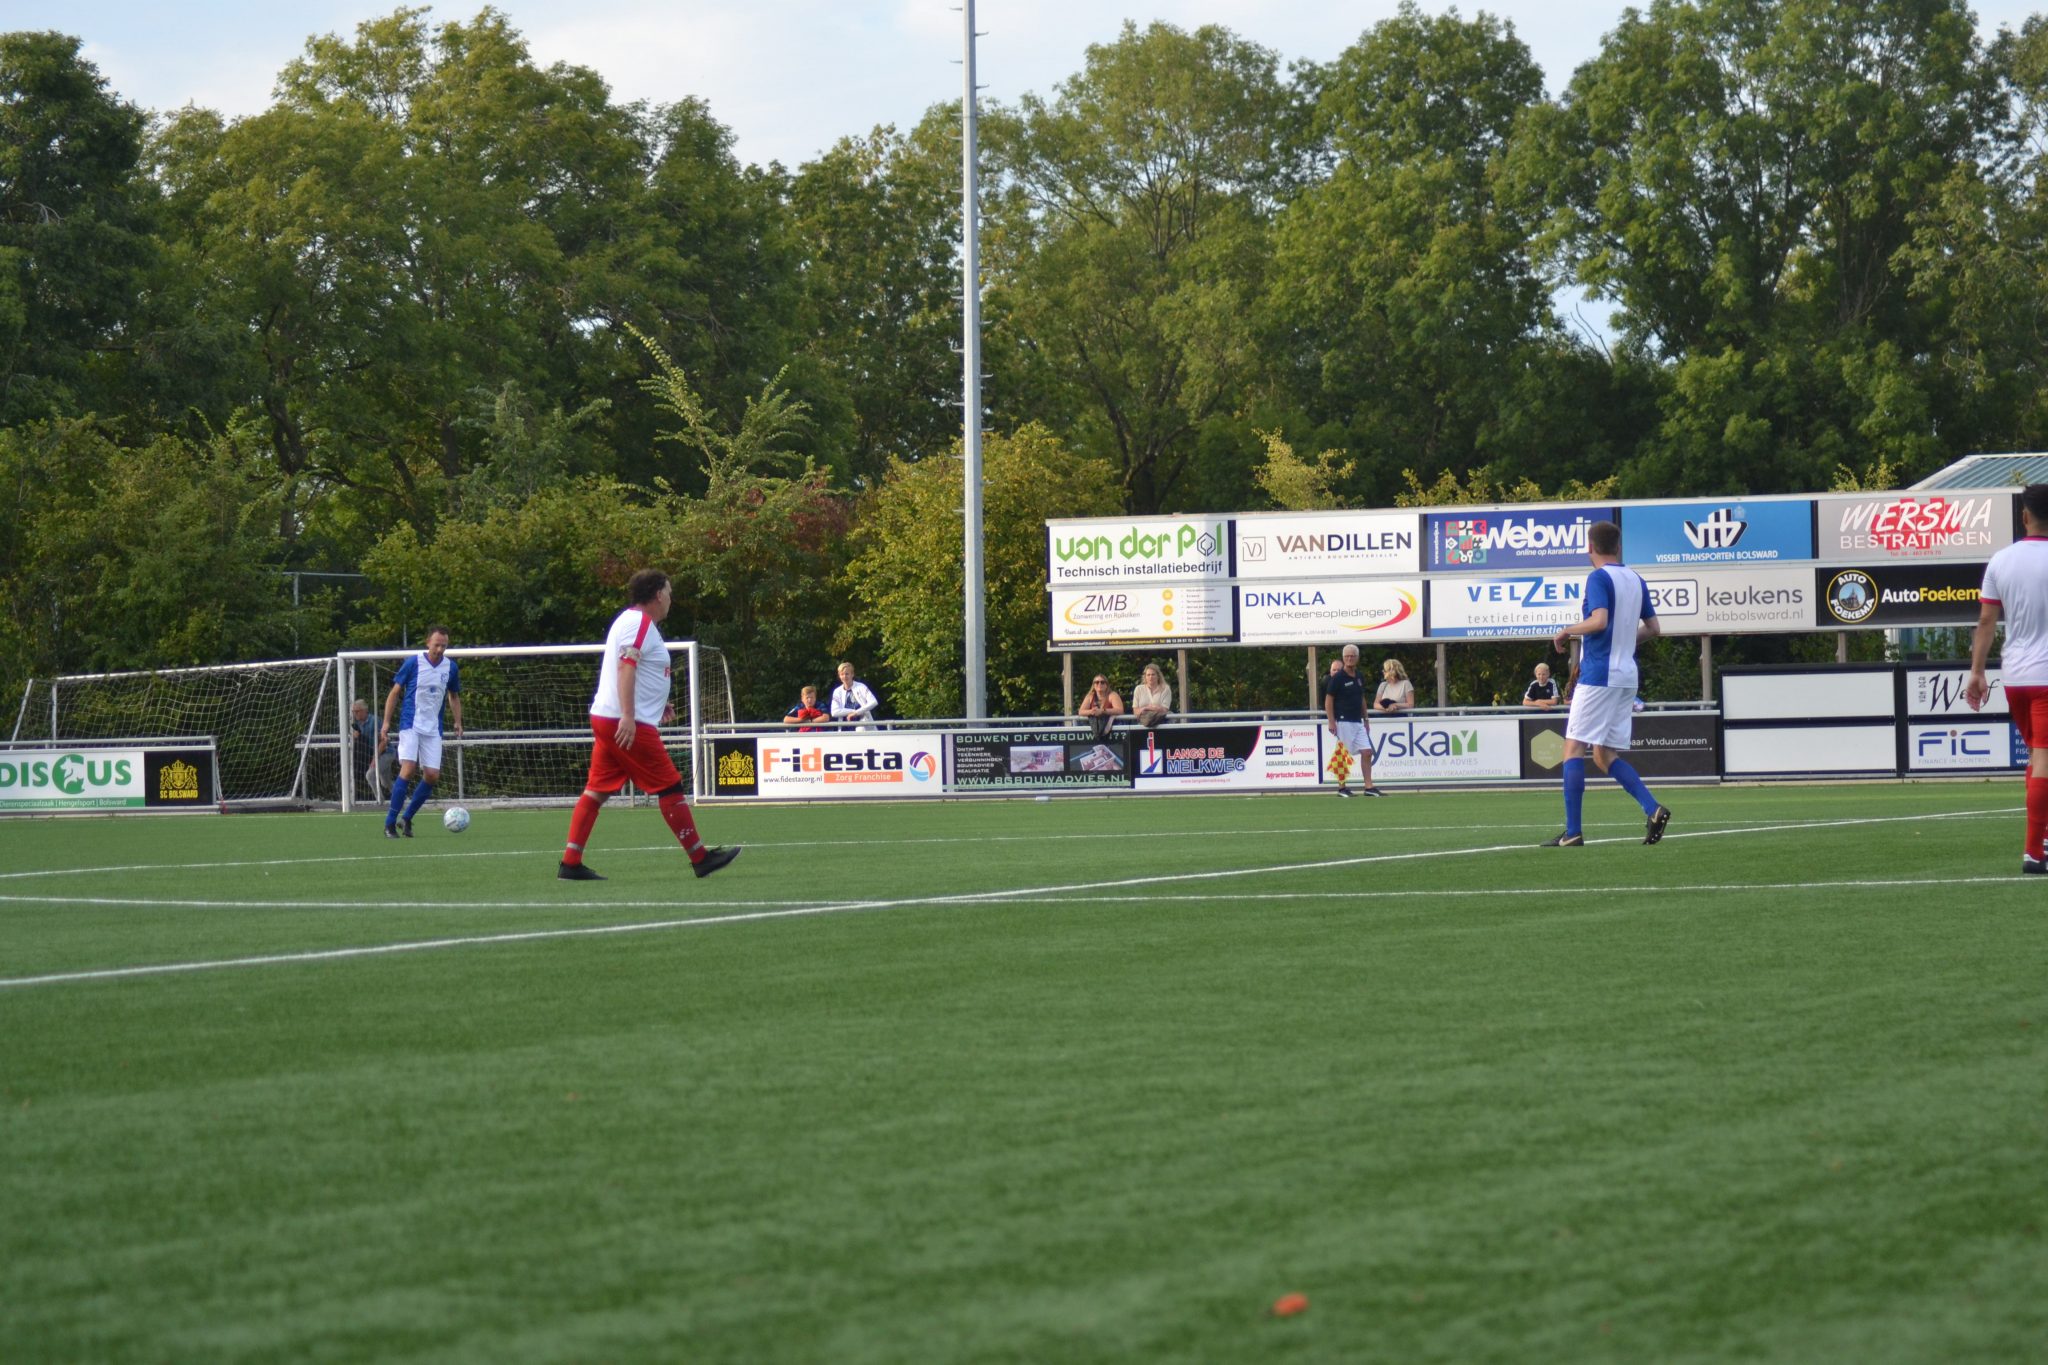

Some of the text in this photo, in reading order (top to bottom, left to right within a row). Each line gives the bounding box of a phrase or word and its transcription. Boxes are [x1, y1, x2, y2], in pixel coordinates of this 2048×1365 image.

[1840, 499, 1992, 532] WIERSMA
[1276, 531, 1412, 553] VANDILLEN
[1484, 517, 1592, 554] Webwij
[1840, 531, 1992, 549] BESTRATINGEN
[1547, 547, 1576, 555] karakter
[1656, 550, 1778, 563] VISSER TRANSPORTEN BOLSWARD
[1057, 561, 1223, 578] Technisch installatiebedrijf
[1838, 573, 1867, 585] AUTO
[1245, 591, 1325, 607] DINKLA
[1467, 577, 1580, 607] VELZEN
[1649, 588, 1690, 607] BKB
[1706, 586, 1803, 606] keukens
[1881, 586, 1981, 603] AutoFoekem
[1084, 594, 1128, 612] ZMB
[1830, 598, 1875, 620] FOEKEMA
[1267, 608, 1392, 620] verkeersopleidingen
[1467, 612, 1581, 624] textielreiniging
[1706, 609, 1804, 622] bkbbolsward.nl
[1929, 673, 2000, 712] Wf
[956, 735, 1009, 744] BOUWEN
[1014, 734, 1030, 742] OF
[1368, 722, 1450, 767] yska
[1646, 737, 1708, 746] Verduurzamen
[762, 748, 903, 772] F-idesta
[1166, 747, 1225, 760] LANGS DE
[1166, 757, 1246, 775] MELKWEG
[1379, 758, 1438, 768] ADMINISTRATIE
[1449, 757, 1478, 766] ADVIES
[0, 753, 132, 795] DISCUS
[763, 772, 892, 784] www.fidestazorg.nl Zorg Franchise
[957, 774, 1127, 786] WWW.BGBOUWADVIES.NL
[58, 798, 95, 807] Hengelsport
[159, 789, 199, 799] SC BOLSWARD
